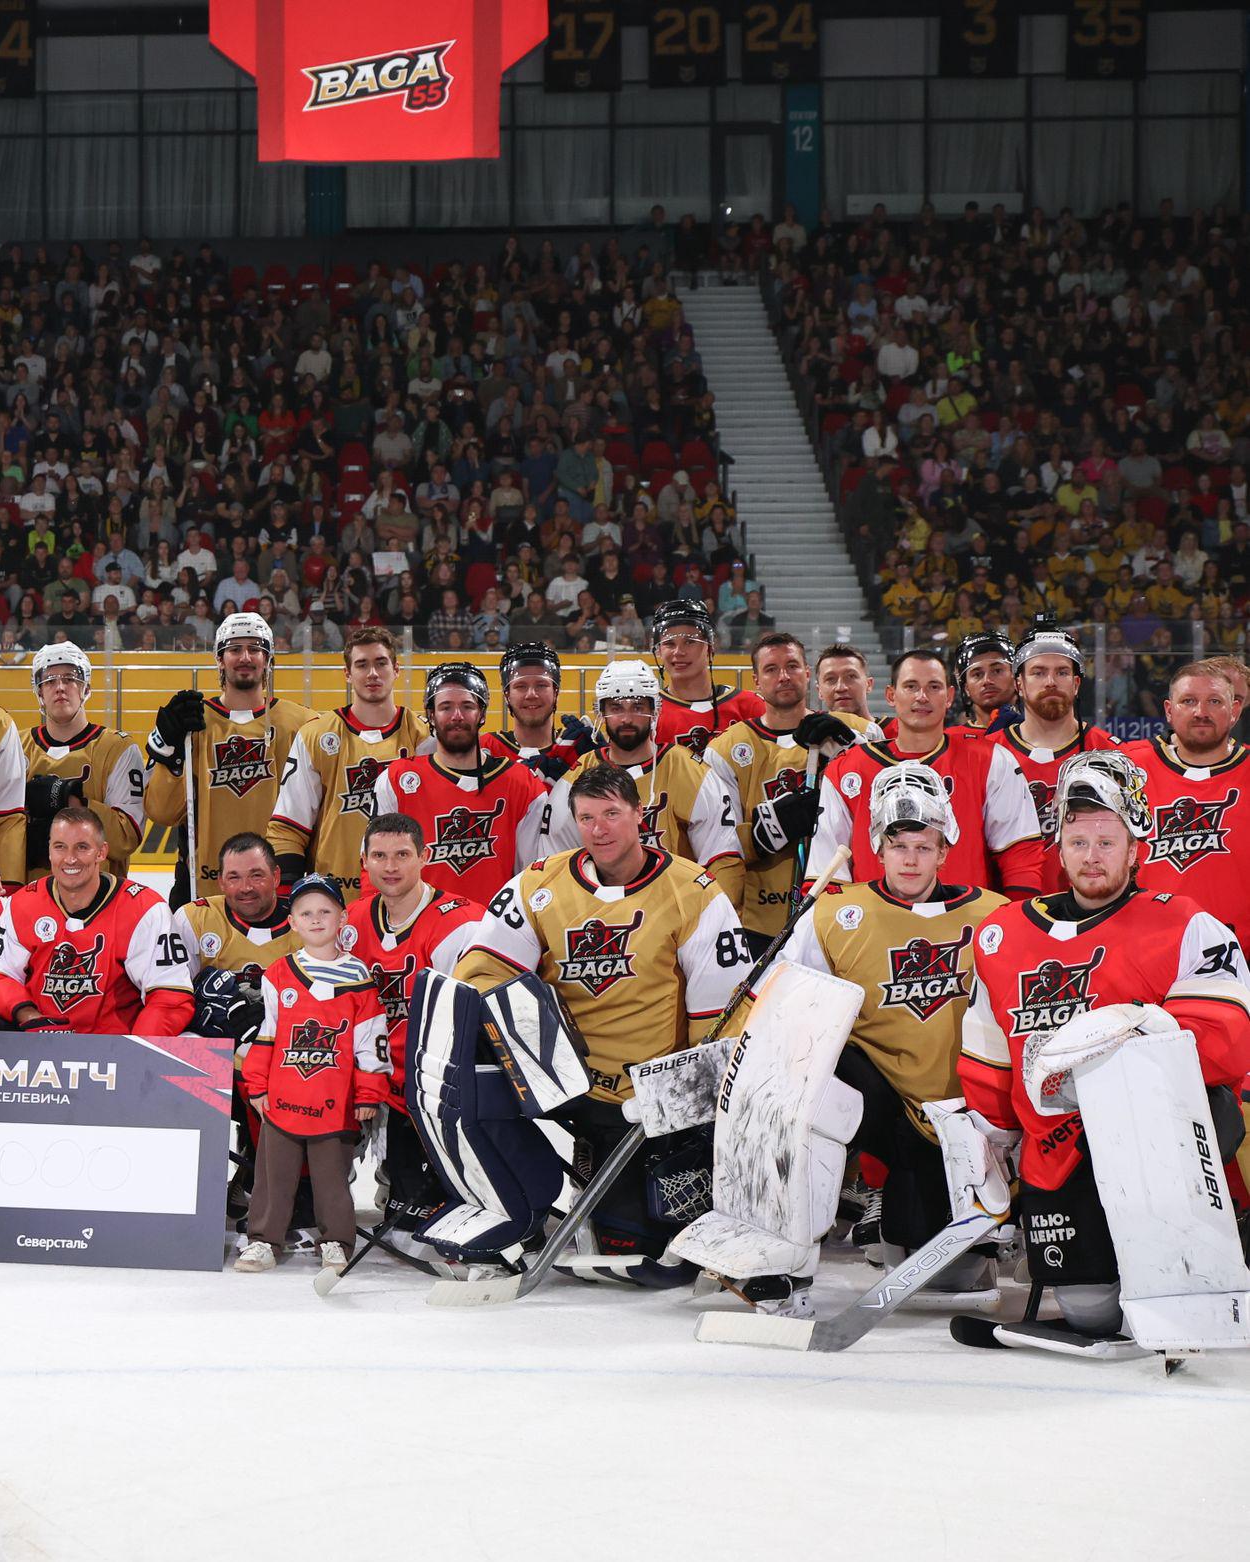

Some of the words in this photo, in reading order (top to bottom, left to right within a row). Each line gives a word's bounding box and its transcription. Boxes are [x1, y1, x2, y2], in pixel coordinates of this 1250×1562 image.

[653, 7, 721, 54] 20
[743, 3, 818, 52] 24
[963, 0, 997, 45] 3
[1074, 0, 1143, 46] 35
[551, 11, 615, 60] 17
[317, 50, 441, 102] BAGA
[410, 82, 444, 107] 55
[792, 125, 814, 152] 12
[1118, 721, 1140, 738] 12
[209, 763, 268, 784] BAGA
[435, 841, 490, 860] BAGA
[1154, 833, 1220, 858] BAGA
[1179, 851, 1190, 861] 55
[458, 857, 467, 865] 55
[156, 932, 189, 967] 16
[565, 958, 629, 980] BAGA
[921, 971, 953, 980] KISELEVICH
[43, 978, 94, 994] BAGA
[592, 977, 602, 985] 55
[888, 976, 962, 1003] BAGA
[919, 999, 931, 1008] 55
[1026, 1002, 1049, 1010] BOGDAN
[1050, 997, 1082, 1006] KISELEVICH
[1017, 1001, 1088, 1032] BAGA
[285, 1051, 334, 1064] BAGA
[275, 1098, 324, 1119] Severstal
[1041, 1114, 1083, 1155] vers
[16, 1235, 89, 1252] Северсталь
[1030, 1228, 1076, 1244] ЦЕНТР
[861, 1236, 972, 1309] VAPOR
